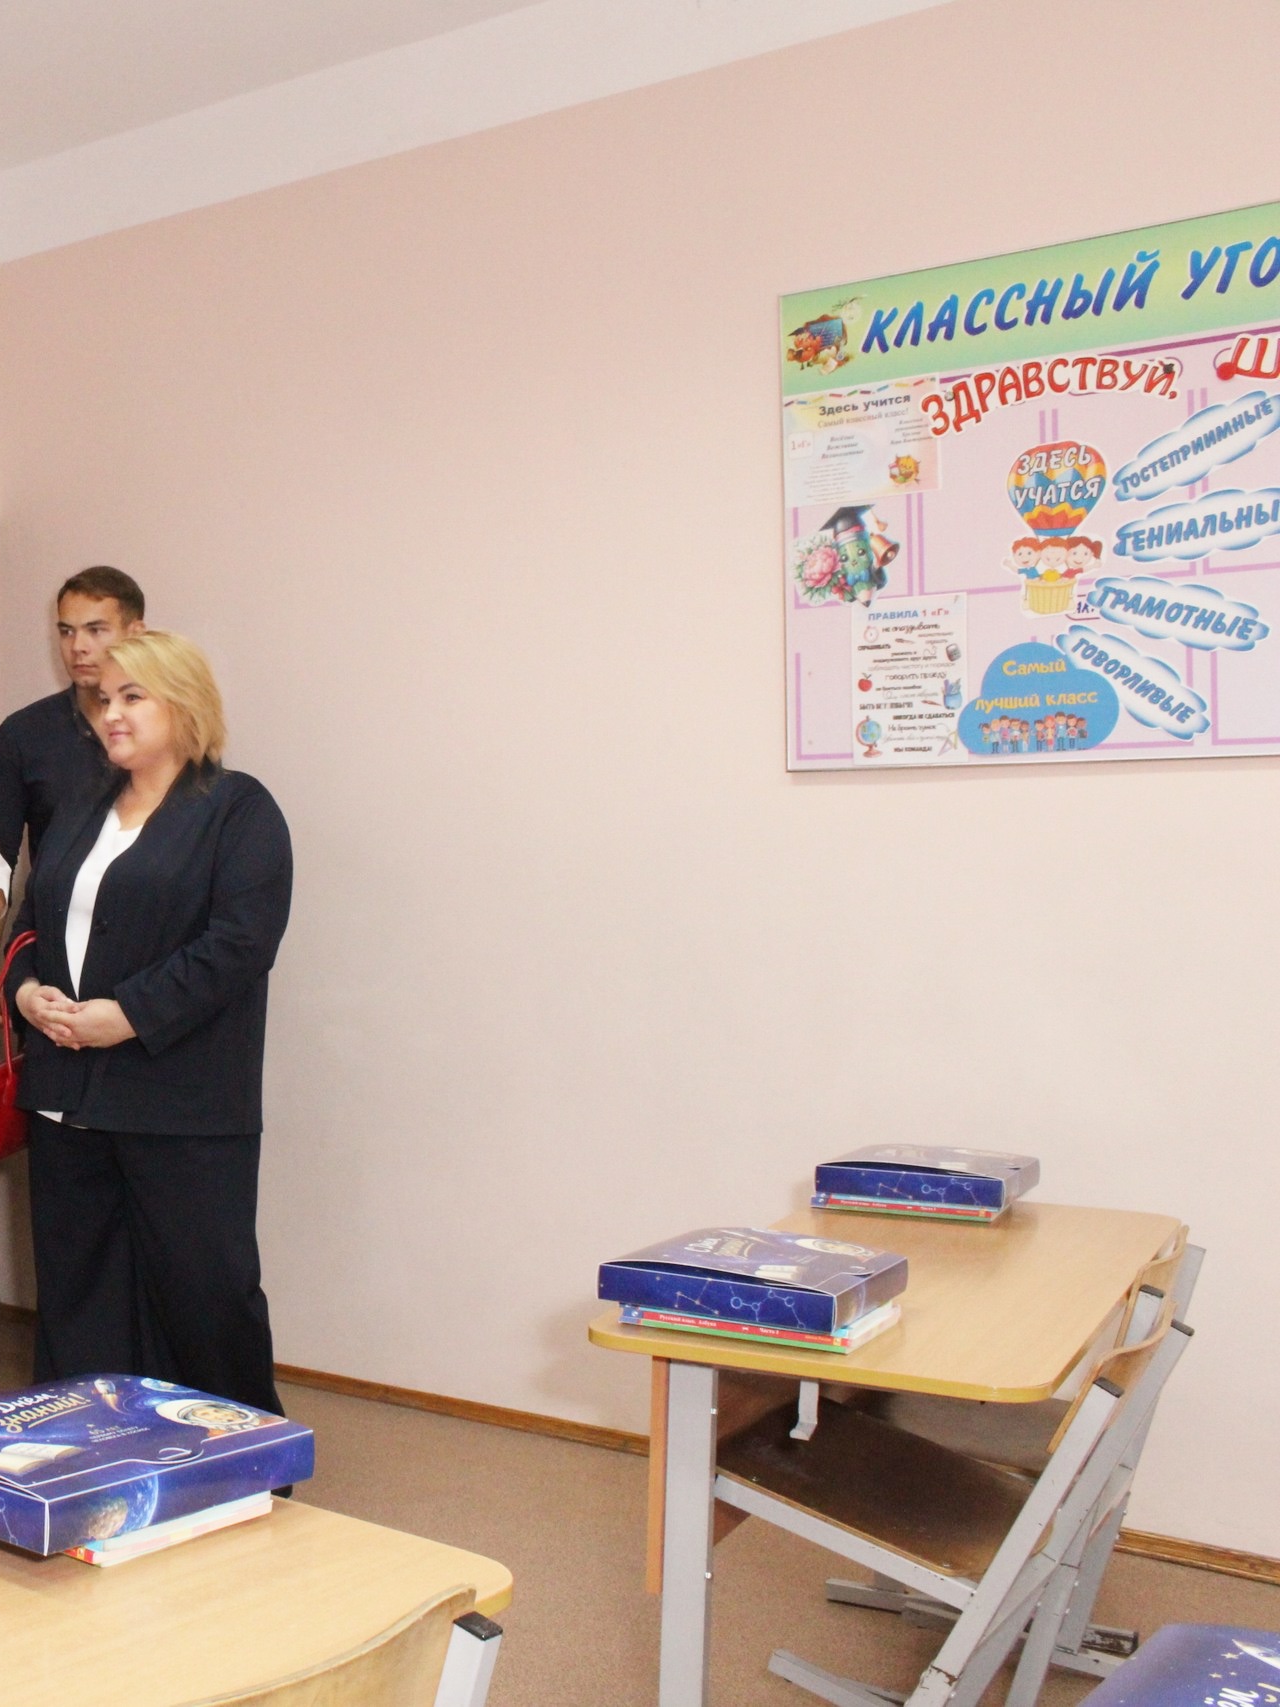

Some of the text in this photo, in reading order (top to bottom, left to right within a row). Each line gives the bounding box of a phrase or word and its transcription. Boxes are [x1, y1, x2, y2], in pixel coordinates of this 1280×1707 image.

[861, 249, 1161, 354] КЛАССНЫЙ
[818, 394, 911, 417] Здесь учится
[1017, 445, 1092, 476] ЗДЕСЬ
[1119, 399, 1274, 494] ГОСТЕПРИИМНЫЕ
[1014, 477, 1102, 508] УЧАТСЯ
[868, 610, 919, 620] ПРАВИЛА
[1094, 586, 1258, 641] ГРАМОТНЫЕ
[1002, 659, 1066, 676] Самый
[1071, 637, 1196, 723] ГОВОРЛИВЫЕ
